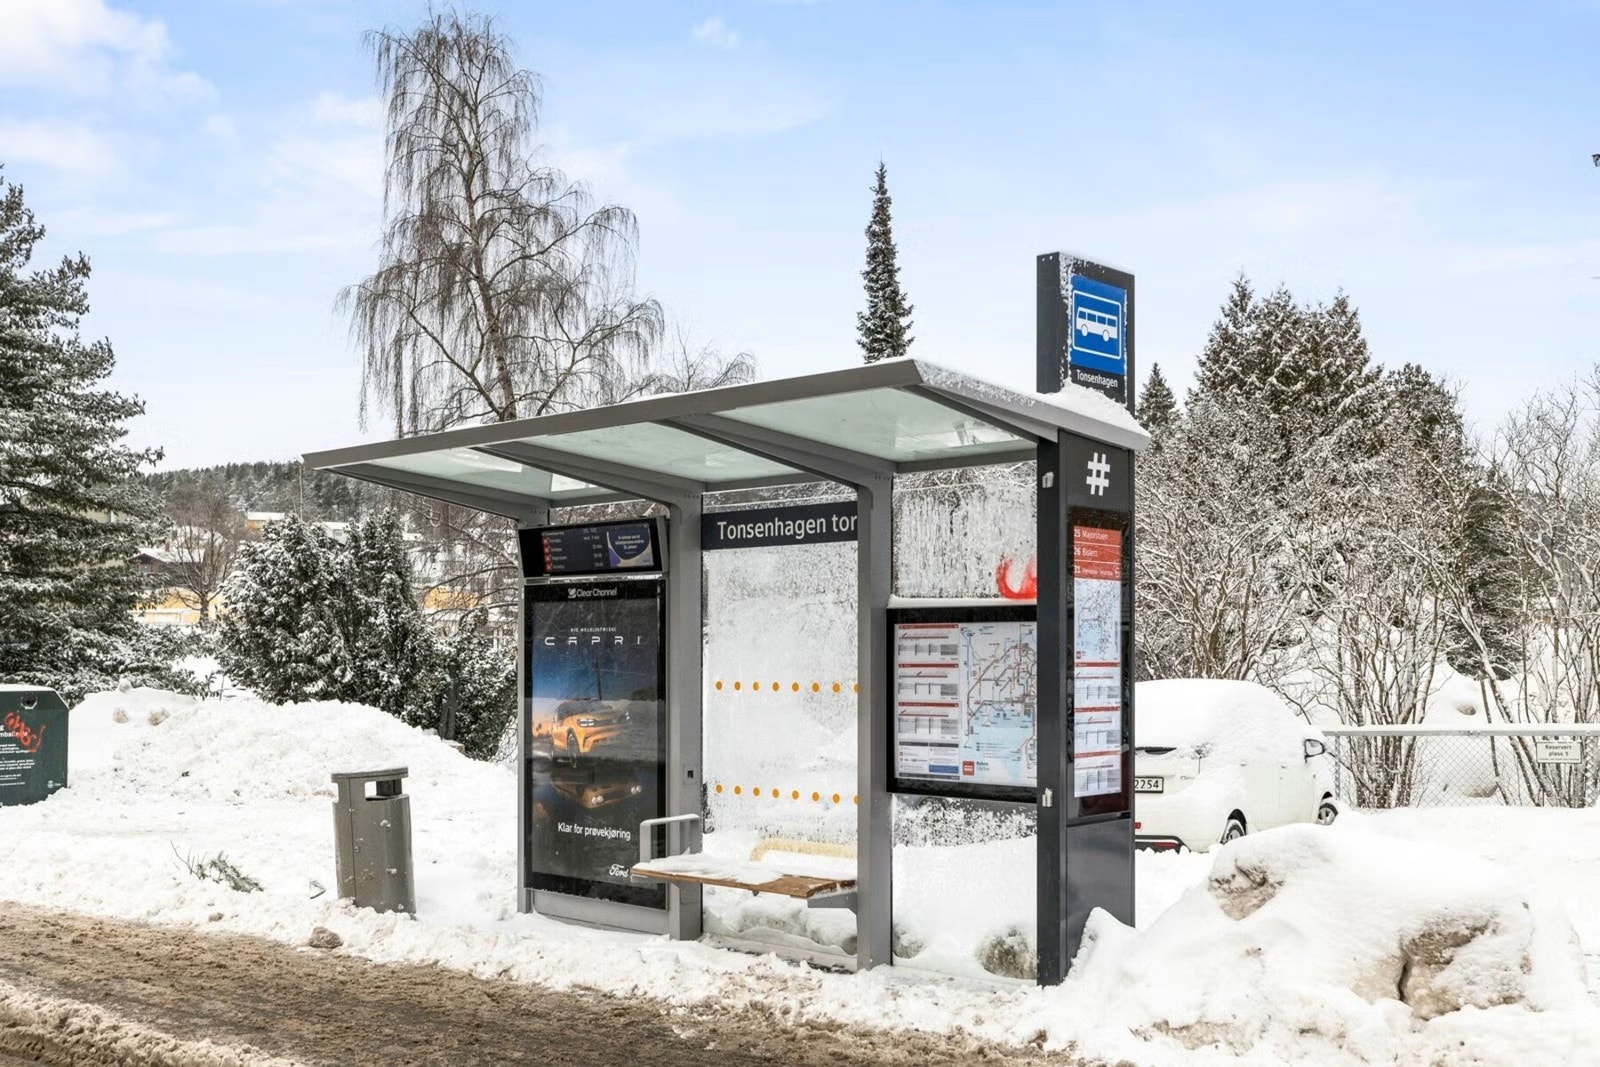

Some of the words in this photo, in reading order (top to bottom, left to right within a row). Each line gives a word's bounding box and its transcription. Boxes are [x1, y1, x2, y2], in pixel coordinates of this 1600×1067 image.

[1076, 369, 1118, 388] Tonsenhagen
[717, 517, 826, 540] Tonsenhagen
[831, 514, 858, 533] tor
[544, 635, 641, 646] CAPRI
[1135, 780, 1159, 789] 2254
[557, 822, 573, 833] Klar
[573, 823, 584, 834] for
[584, 826, 631, 841] prøvekjøring
[609, 863, 629, 877] Ford
